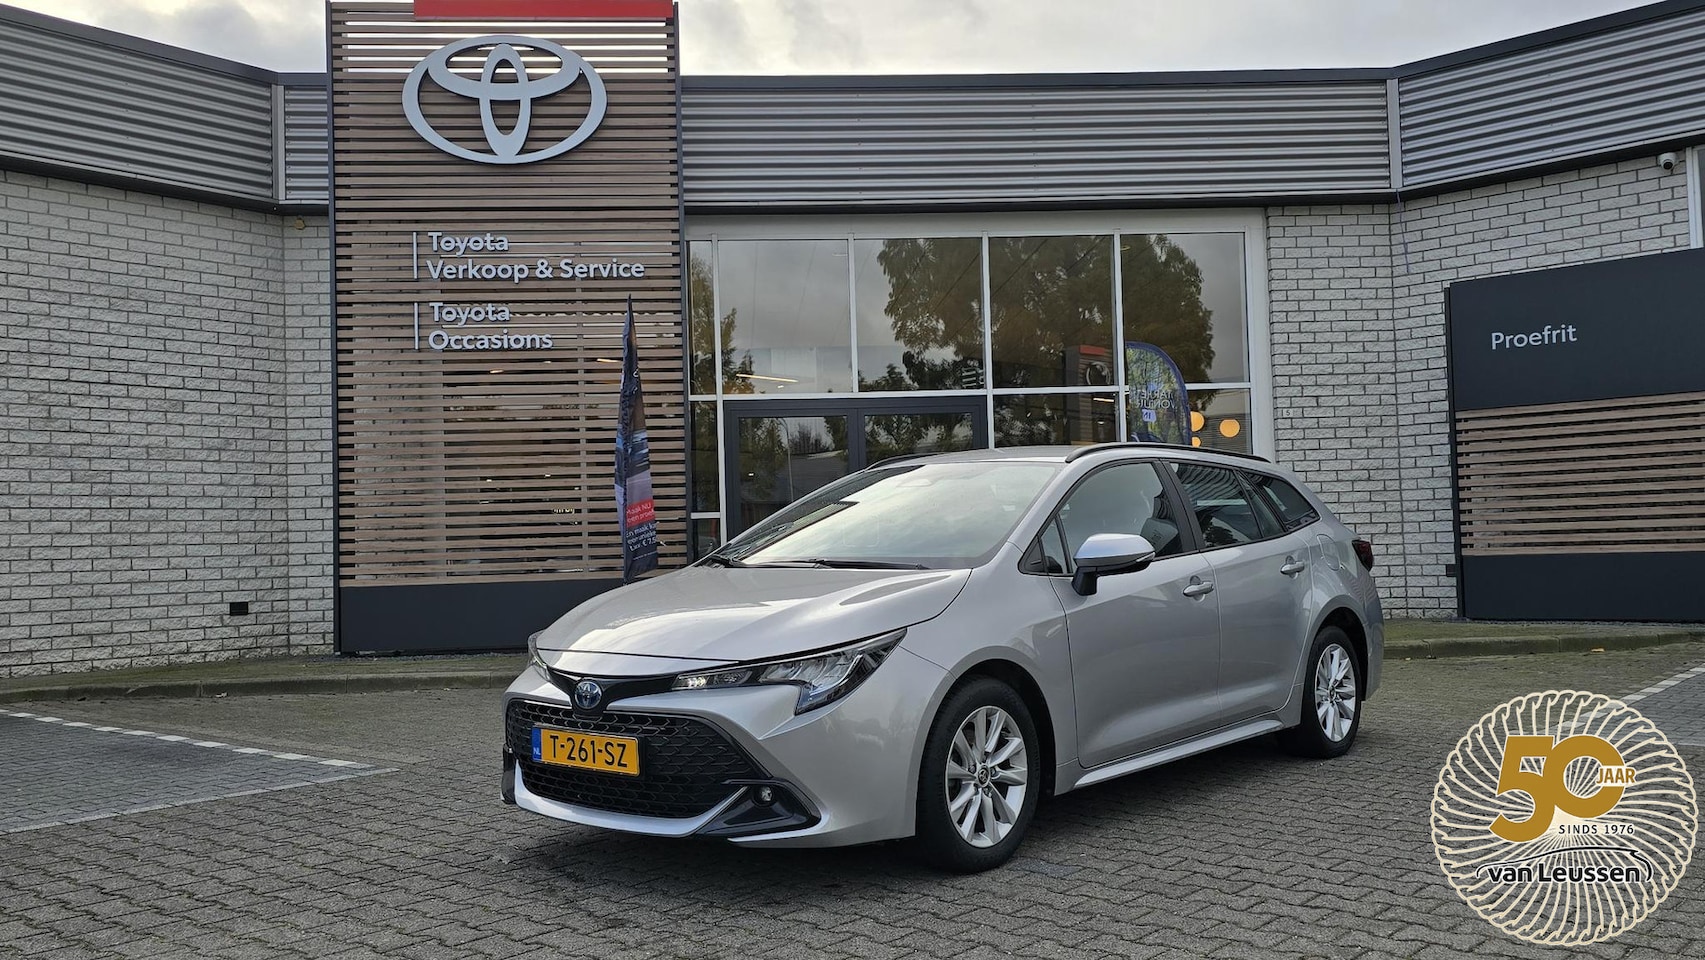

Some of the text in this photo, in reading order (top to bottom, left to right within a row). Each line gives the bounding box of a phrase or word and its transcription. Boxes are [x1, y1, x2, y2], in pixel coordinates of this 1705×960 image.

[428, 231, 509, 256] Toyota
[426, 257, 645, 284] Verkoop & Service
[429, 301, 511, 326] Toyota
[428, 328, 554, 350] Occasions
[1491, 323, 1578, 350] Proefrit
[550, 734, 628, 768] T-261-SZ
